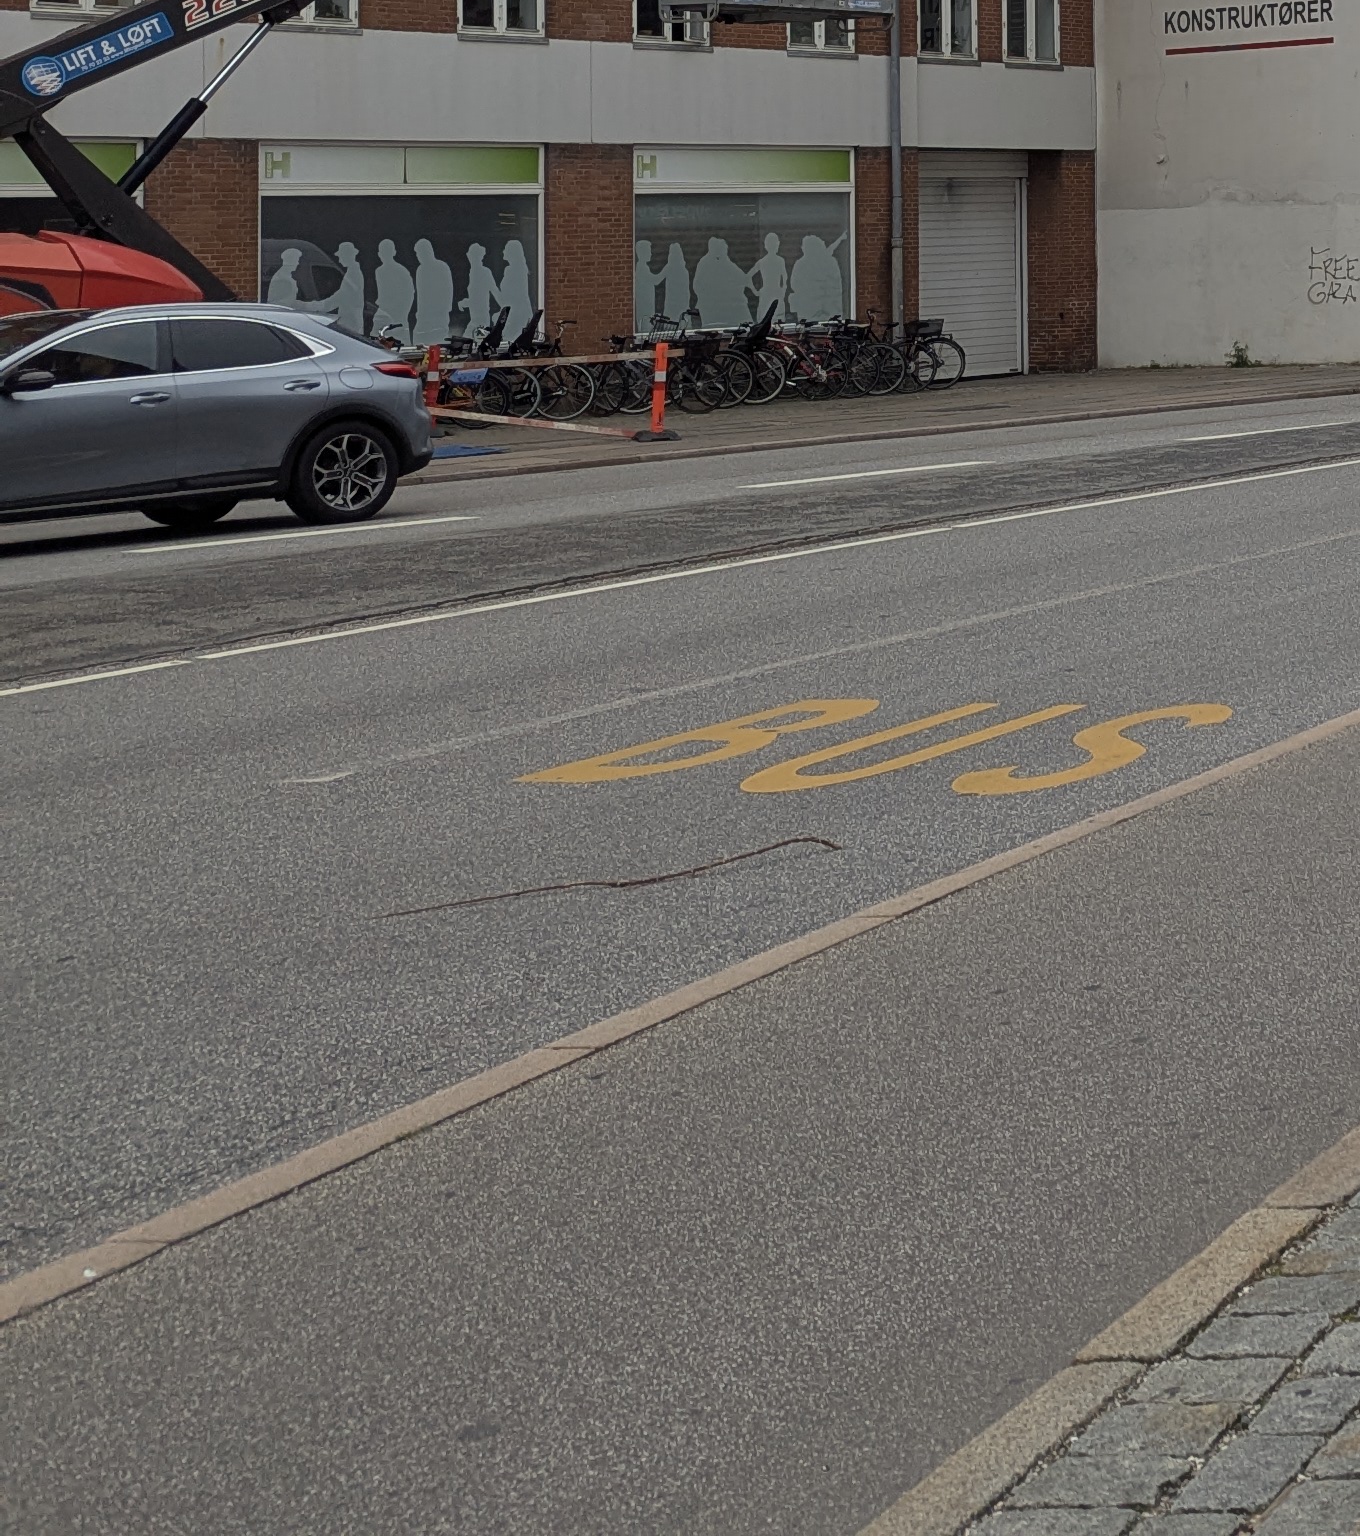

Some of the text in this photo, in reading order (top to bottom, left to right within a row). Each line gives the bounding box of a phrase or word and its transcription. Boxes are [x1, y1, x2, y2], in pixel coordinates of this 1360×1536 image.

[62, 46, 96, 72] LIFT
[101, 40, 116, 55] &
[118, 17, 162, 48] LØFT
[1308, 246, 1360, 281] FREE
[1307, 281, 1357, 305] GAZA
[512, 698, 1233, 796] BUS
